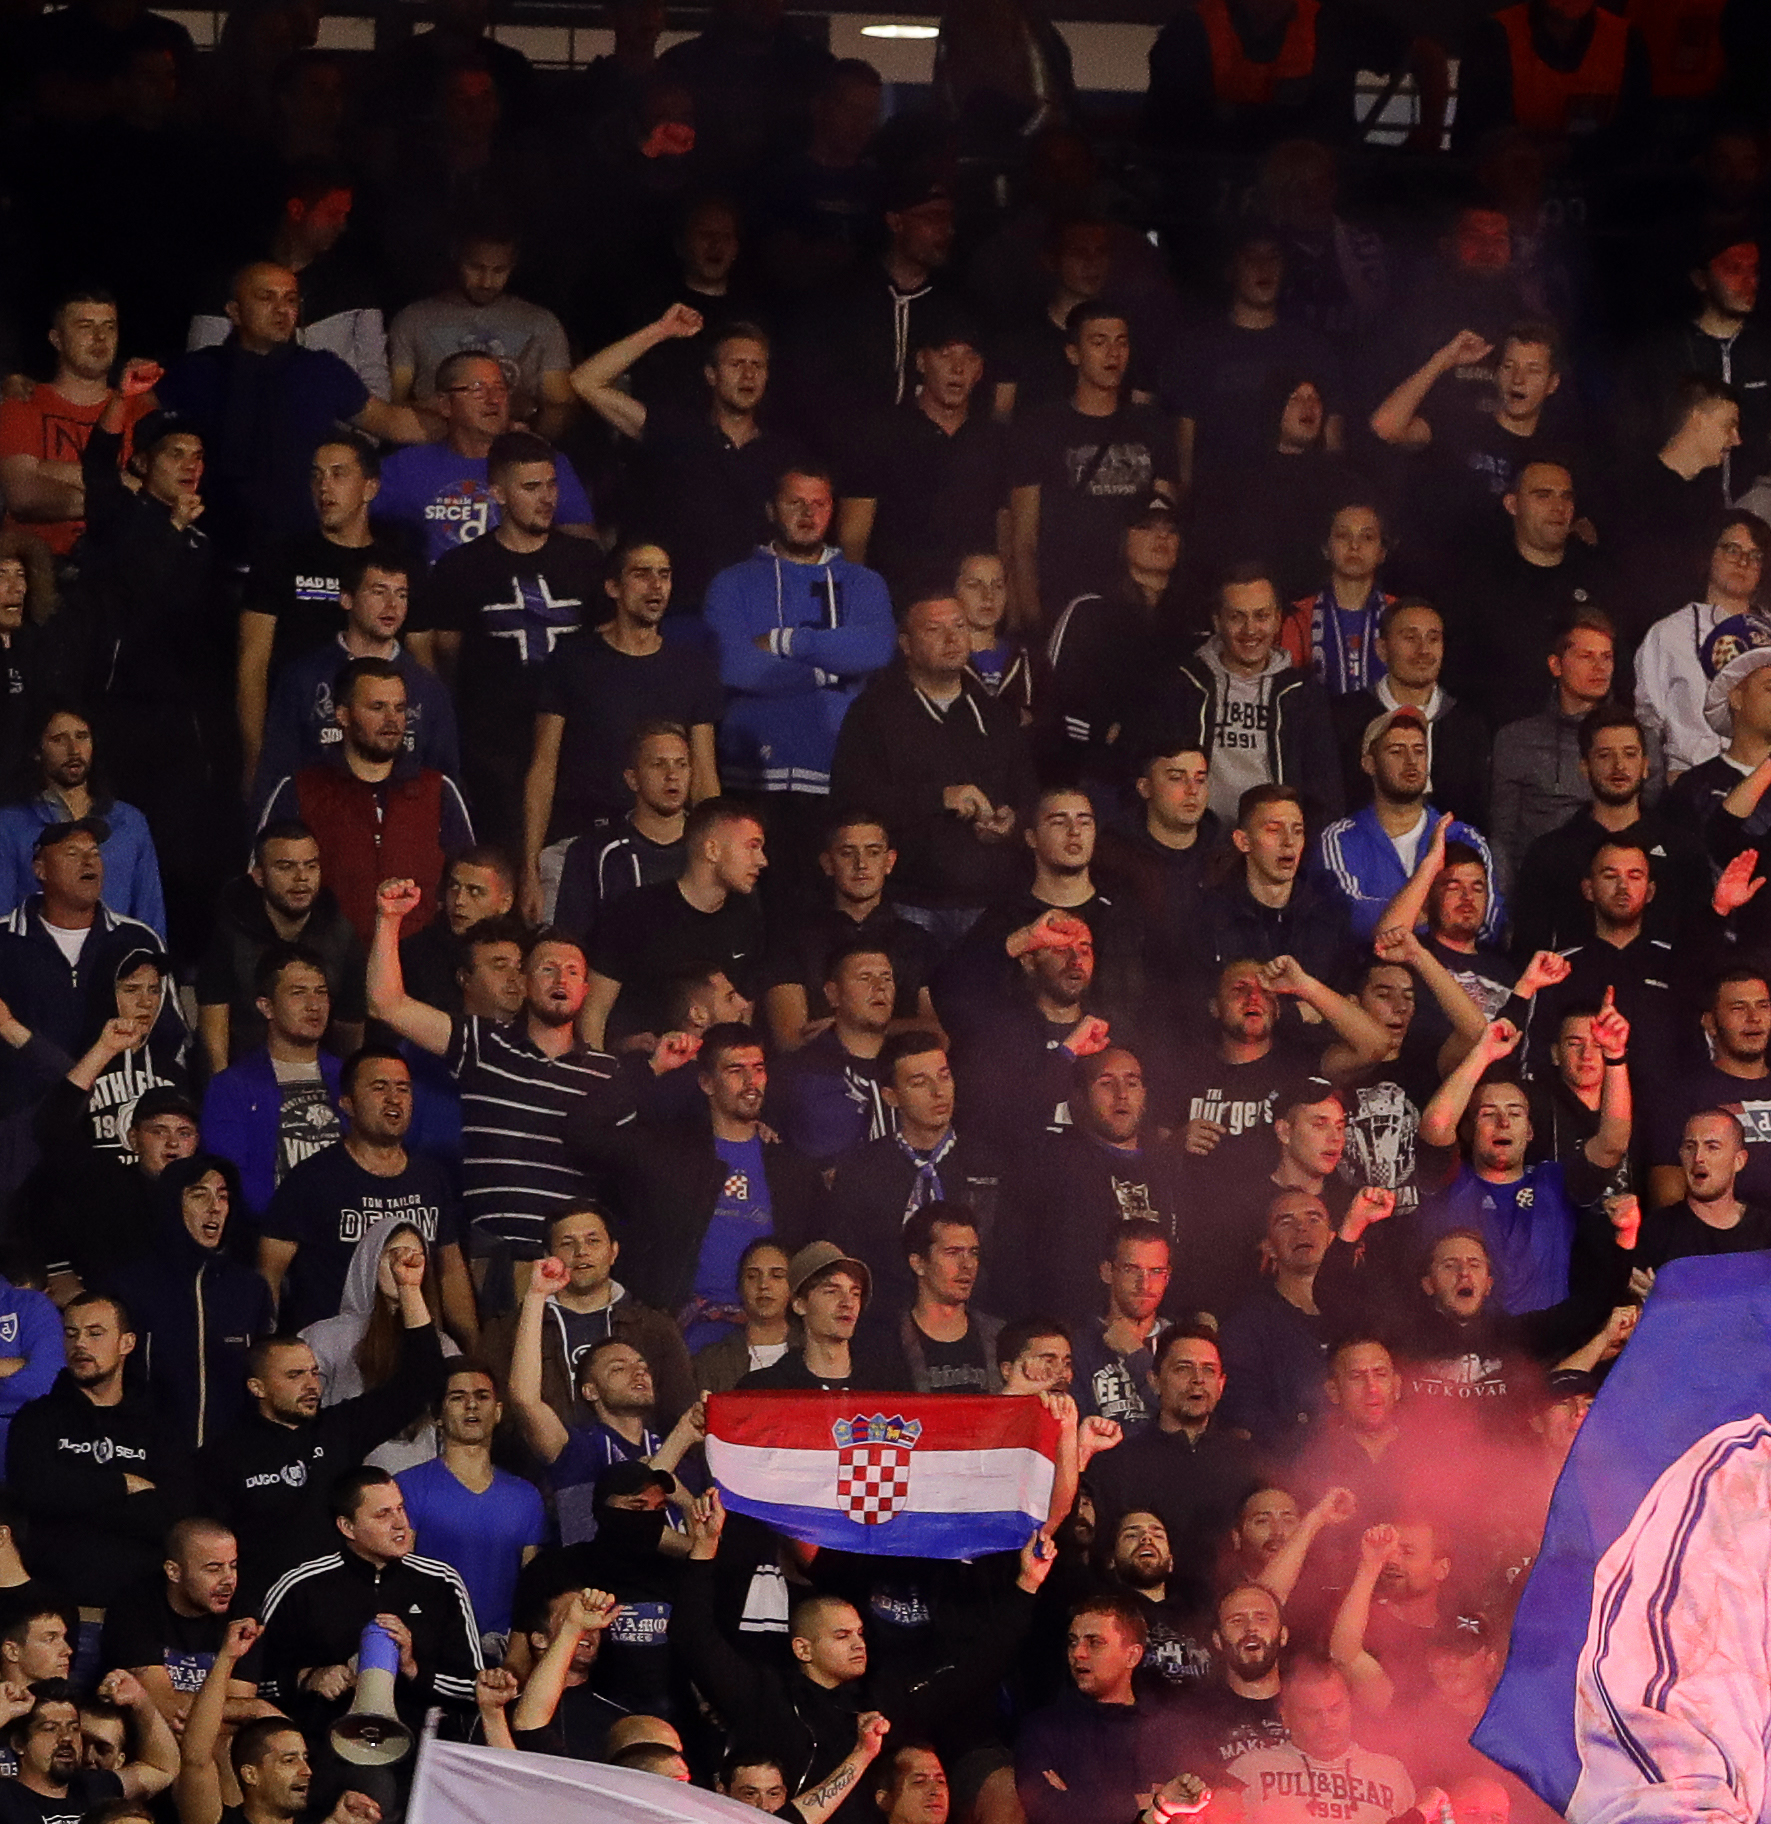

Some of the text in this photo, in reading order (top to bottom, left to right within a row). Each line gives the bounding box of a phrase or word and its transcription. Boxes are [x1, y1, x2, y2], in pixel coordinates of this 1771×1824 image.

[424, 506, 471, 522] SRCE
[296, 575, 325, 589] BAD
[1216, 731, 1258, 749] 1991
[90, 1069, 178, 1113] ATHLE
[362, 1196, 381, 1211] TOM
[1412, 1382, 1508, 1399] VUKOVAR
[245, 1472, 282, 1489] DUGO
[610, 1617, 668, 1634] NAMO
[1259, 1770, 1396, 1815] PULL&BEAR
[1304, 1800, 1357, 1821] 1991
